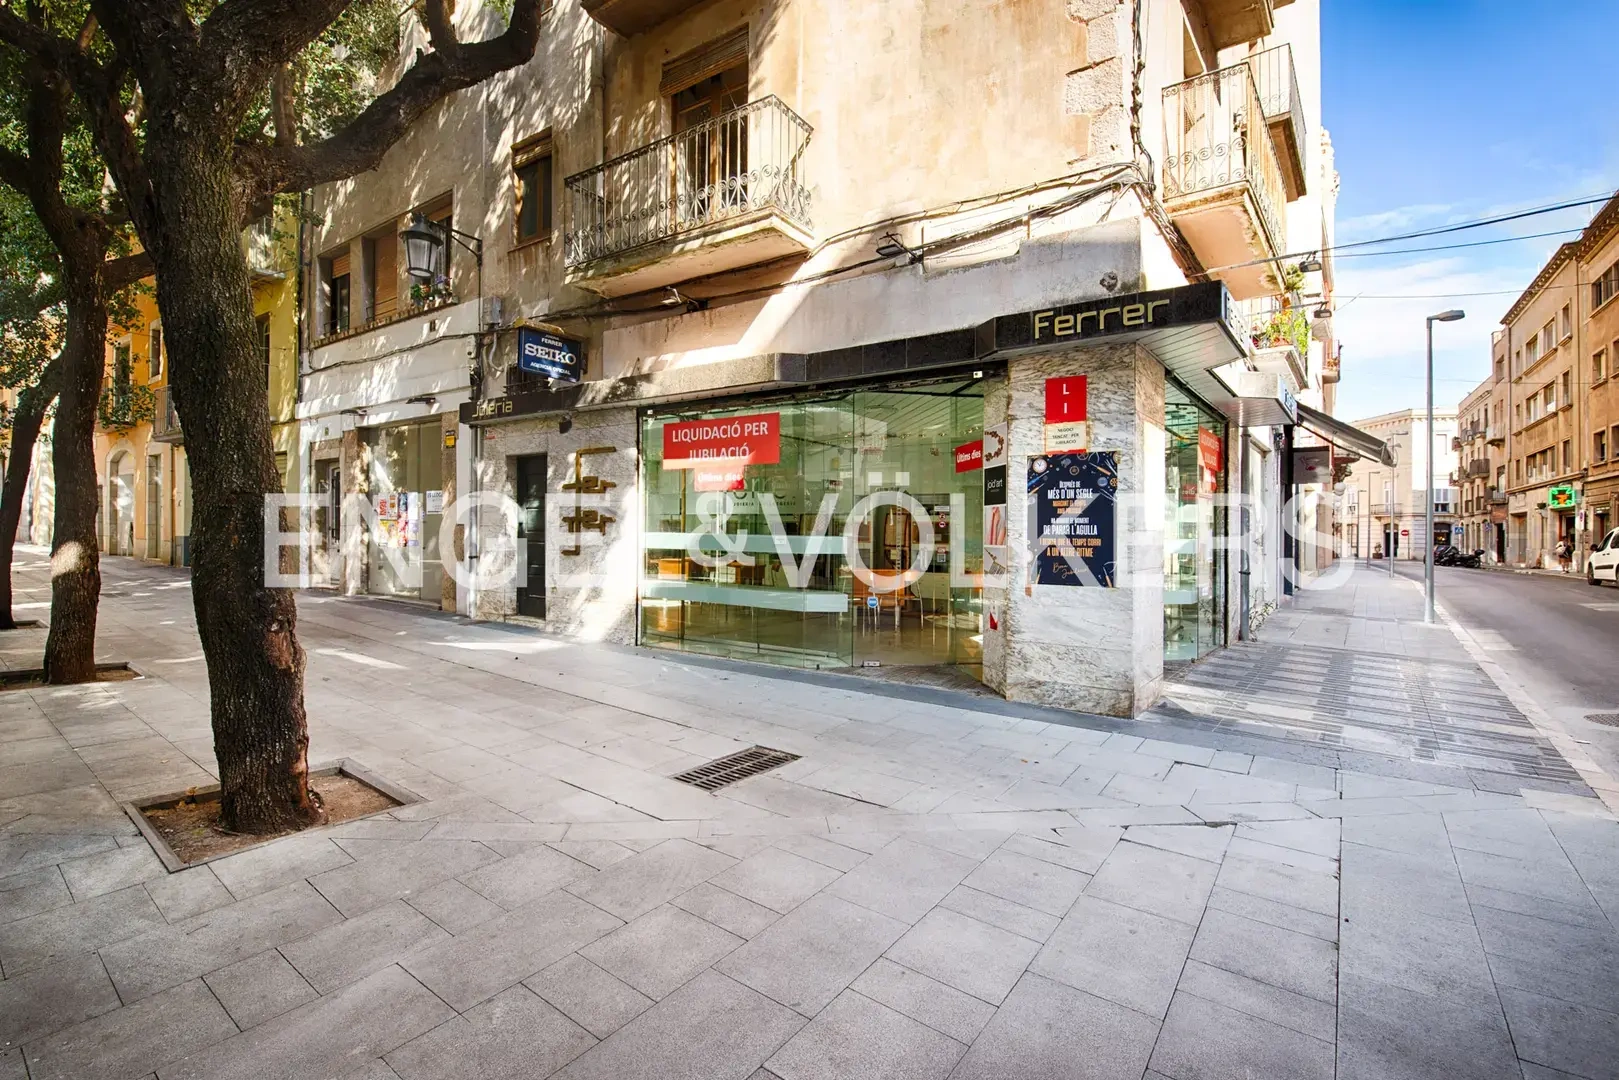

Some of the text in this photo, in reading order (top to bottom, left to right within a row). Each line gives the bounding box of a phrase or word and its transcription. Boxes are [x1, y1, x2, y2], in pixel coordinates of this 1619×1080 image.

[1034, 299, 1170, 340] Ferrer
[541, 338, 563, 348] FERRER
[524, 343, 577, 365] SEIKO
[672, 420, 769, 443] LIQUIDACIÓ PER
[689, 442, 750, 461] JUBILACIÓ
[1048, 486, 1093, 499] MÉS D'UN SEGLE
[1043, 525, 1050, 535] DE
